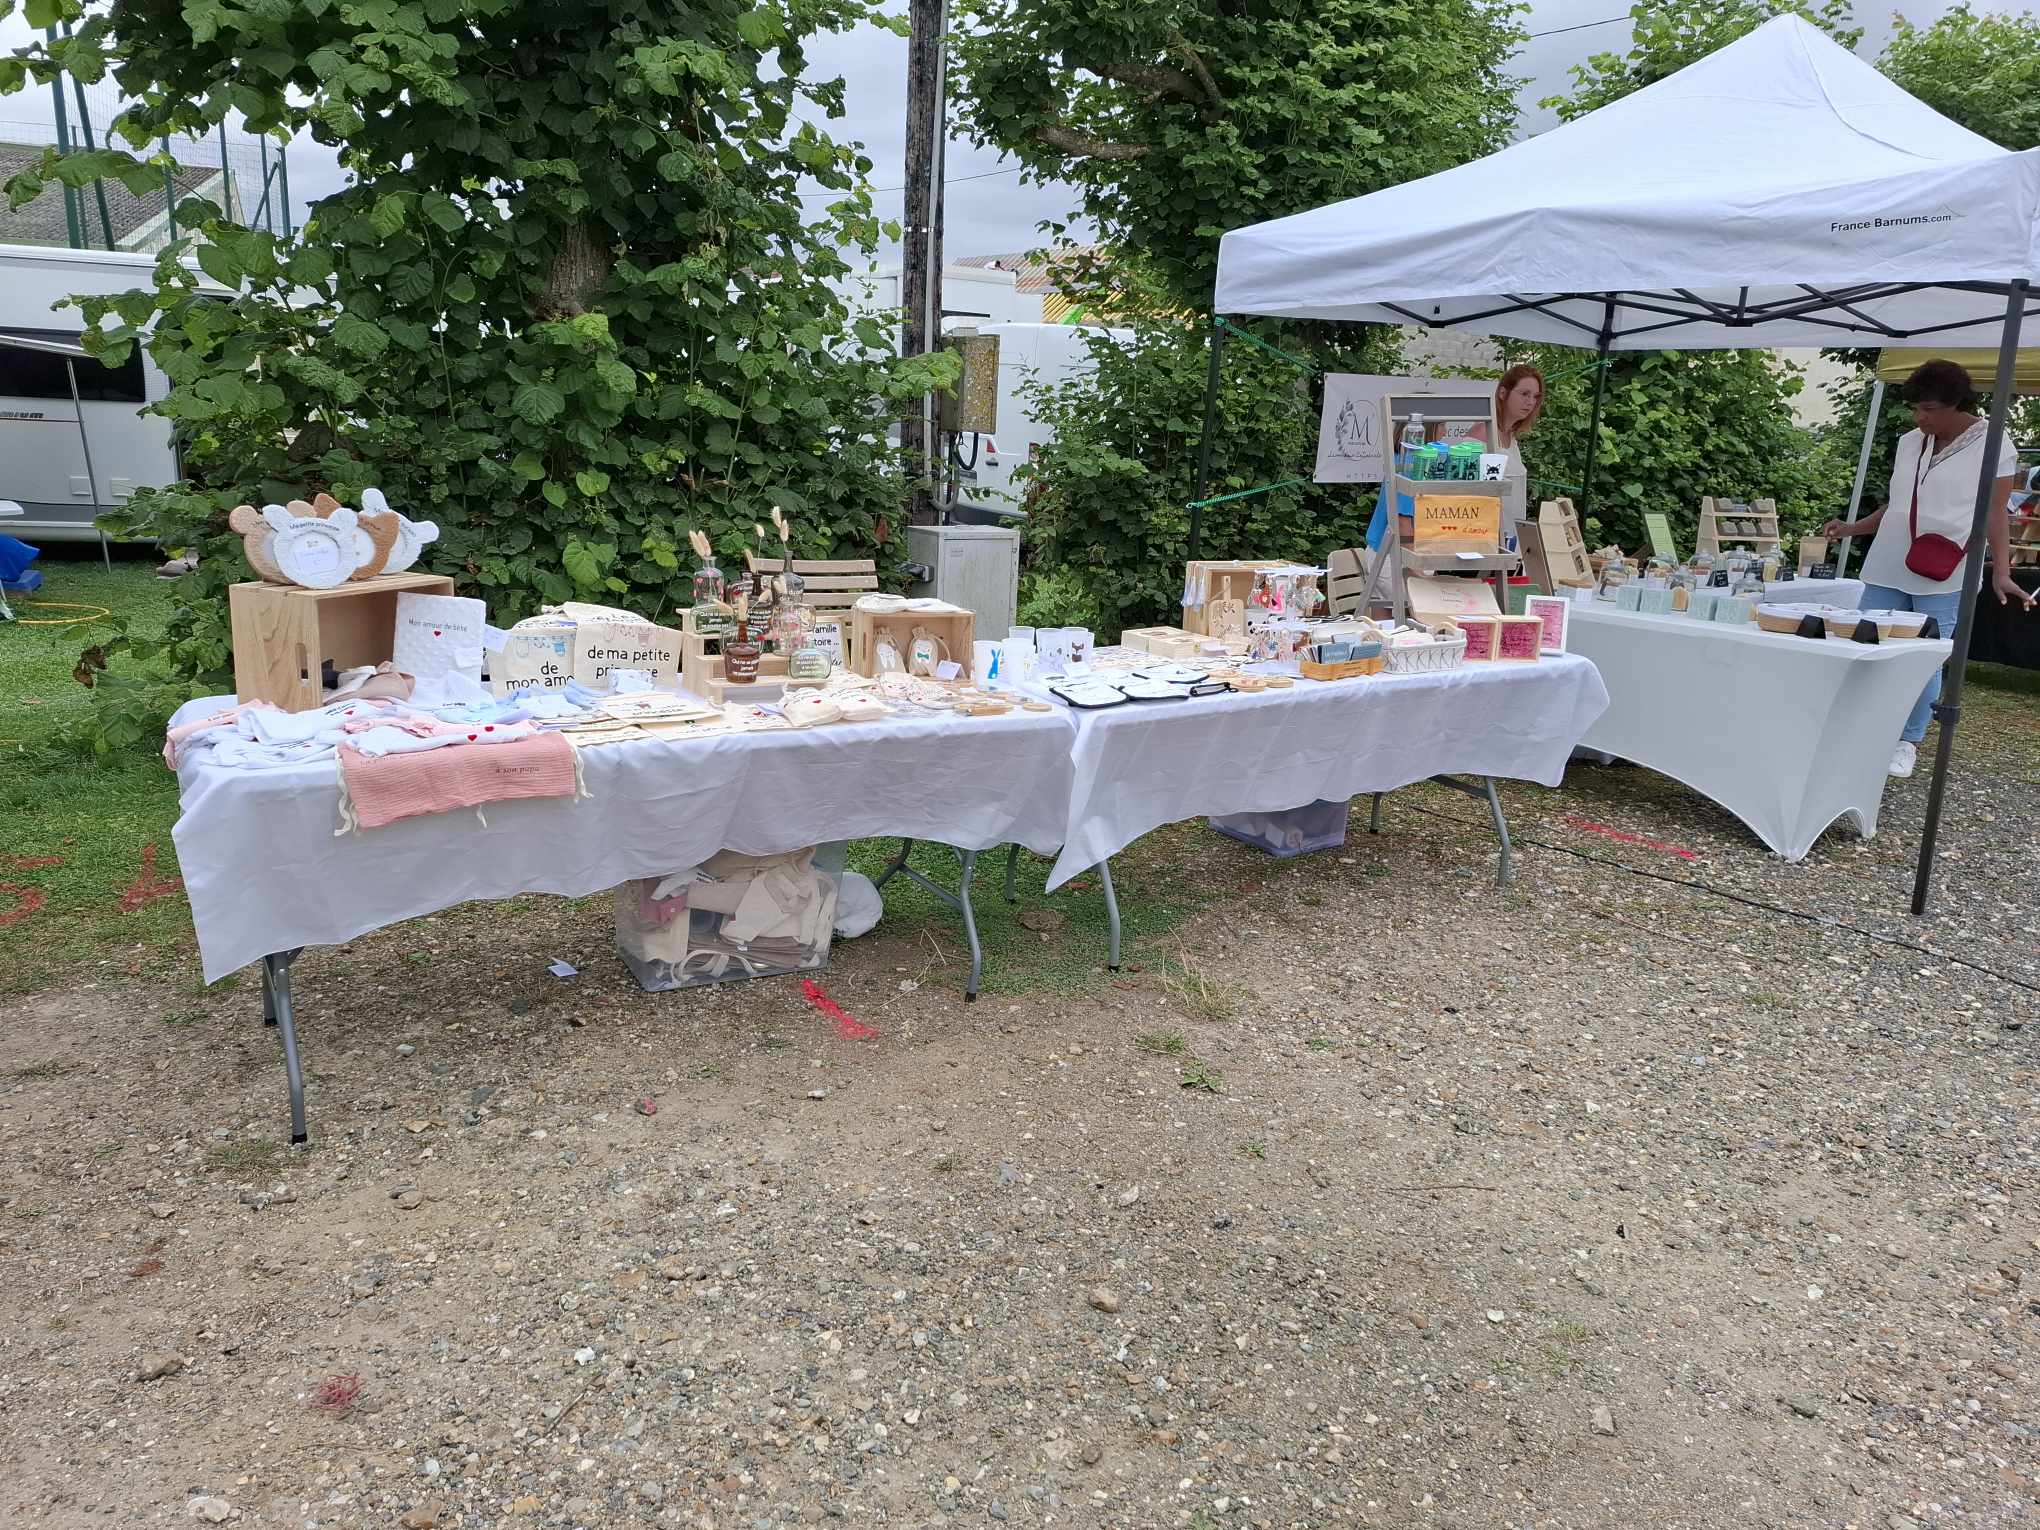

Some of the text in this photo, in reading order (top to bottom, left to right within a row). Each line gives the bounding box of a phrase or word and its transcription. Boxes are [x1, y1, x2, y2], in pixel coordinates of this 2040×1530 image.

[1830, 214, 1952, 232] France Barnums.com
[1426, 507, 1480, 520] MAMAN
[588, 645, 671, 663] de ma petite
[540, 661, 558, 675] de
